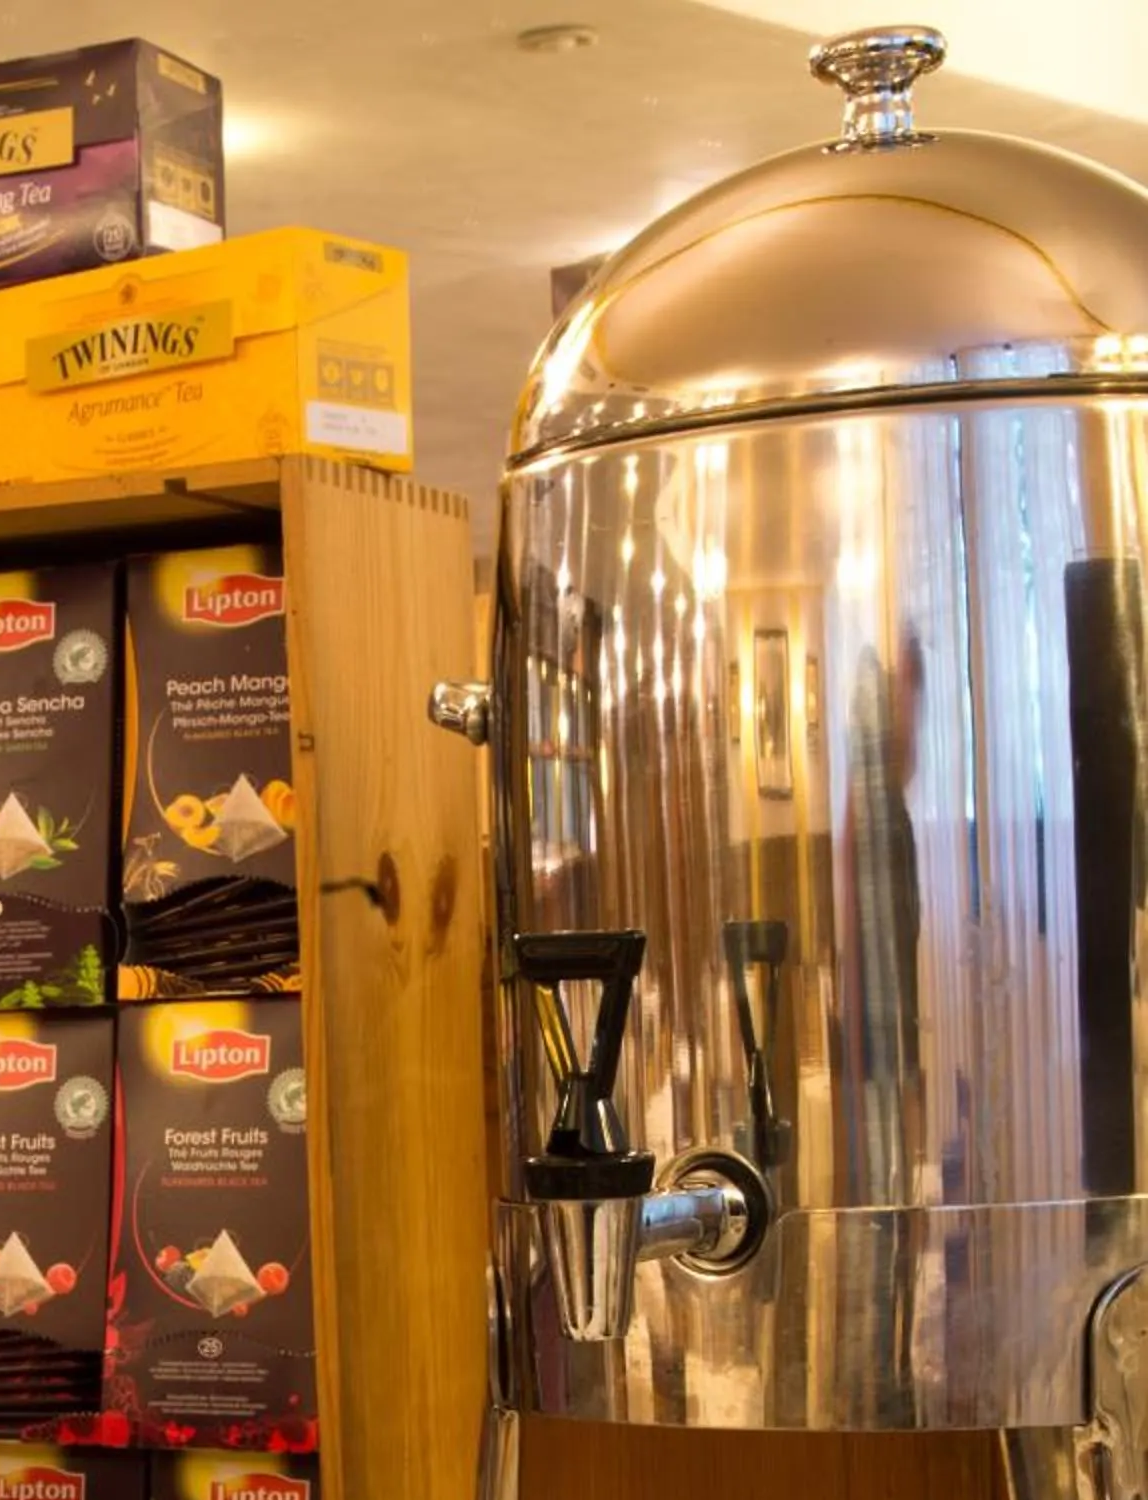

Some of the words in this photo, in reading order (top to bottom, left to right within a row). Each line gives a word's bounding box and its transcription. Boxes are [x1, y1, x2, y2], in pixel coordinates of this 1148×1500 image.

[19, 182, 52, 207] Tea
[52, 322, 199, 381] TWININGS
[173, 381, 203, 404] Tea
[193, 589, 276, 616] Lipton
[166, 677, 225, 697] Peach
[231, 674, 290, 693] Mang
[17, 694, 86, 713] Sencha
[179, 1044, 261, 1071] Lipton
[11, 1133, 56, 1151] Fruits
[164, 1128, 216, 1145] Forest
[221, 1127, 269, 1144] Fruits
[11, 1152, 51, 1165] Rouges
[221, 1148, 263, 1160] Rouges
